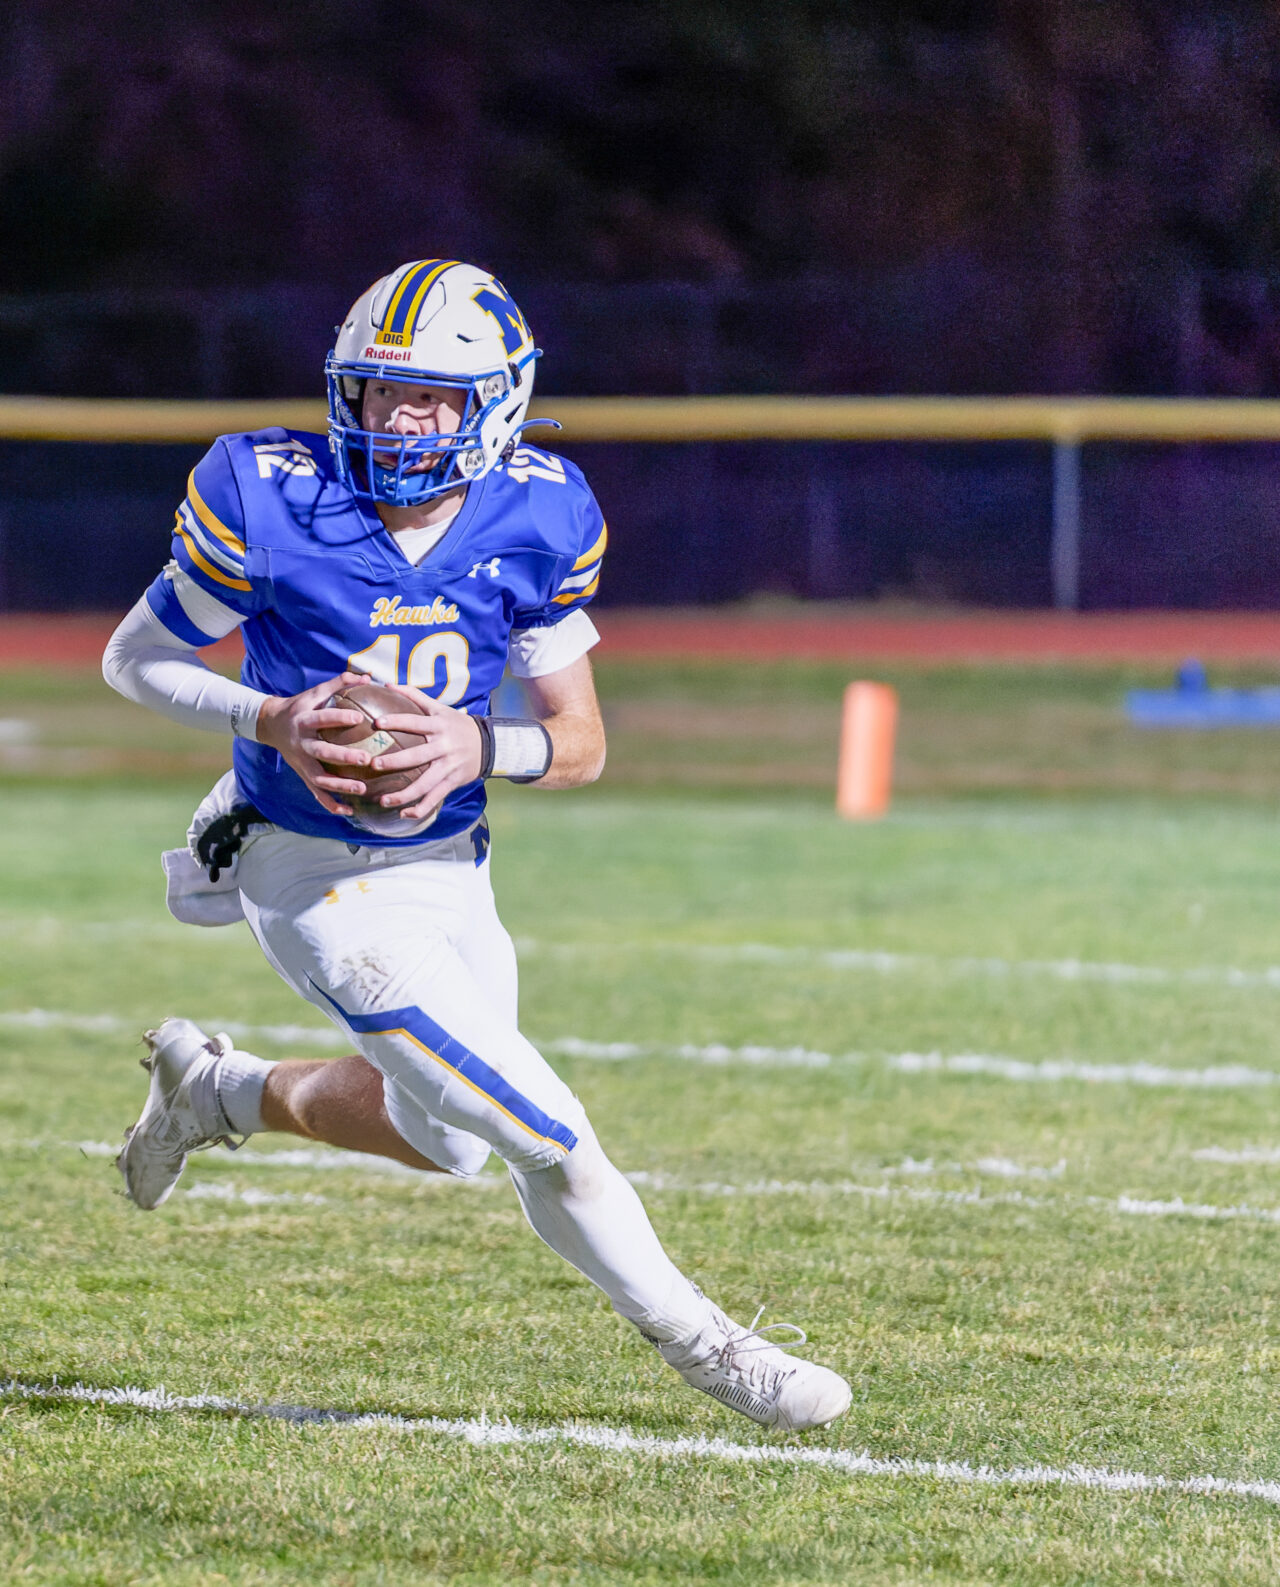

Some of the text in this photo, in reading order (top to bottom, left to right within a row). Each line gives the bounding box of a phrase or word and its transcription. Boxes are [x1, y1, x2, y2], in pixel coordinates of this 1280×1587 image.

[365, 347, 412, 361] Riddell
[383, 333, 404, 345] DIG
[253, 438, 317, 479] 12
[507, 448, 567, 485] 12
[369, 595, 460, 628] Hawks
[347, 631, 470, 714] 12
